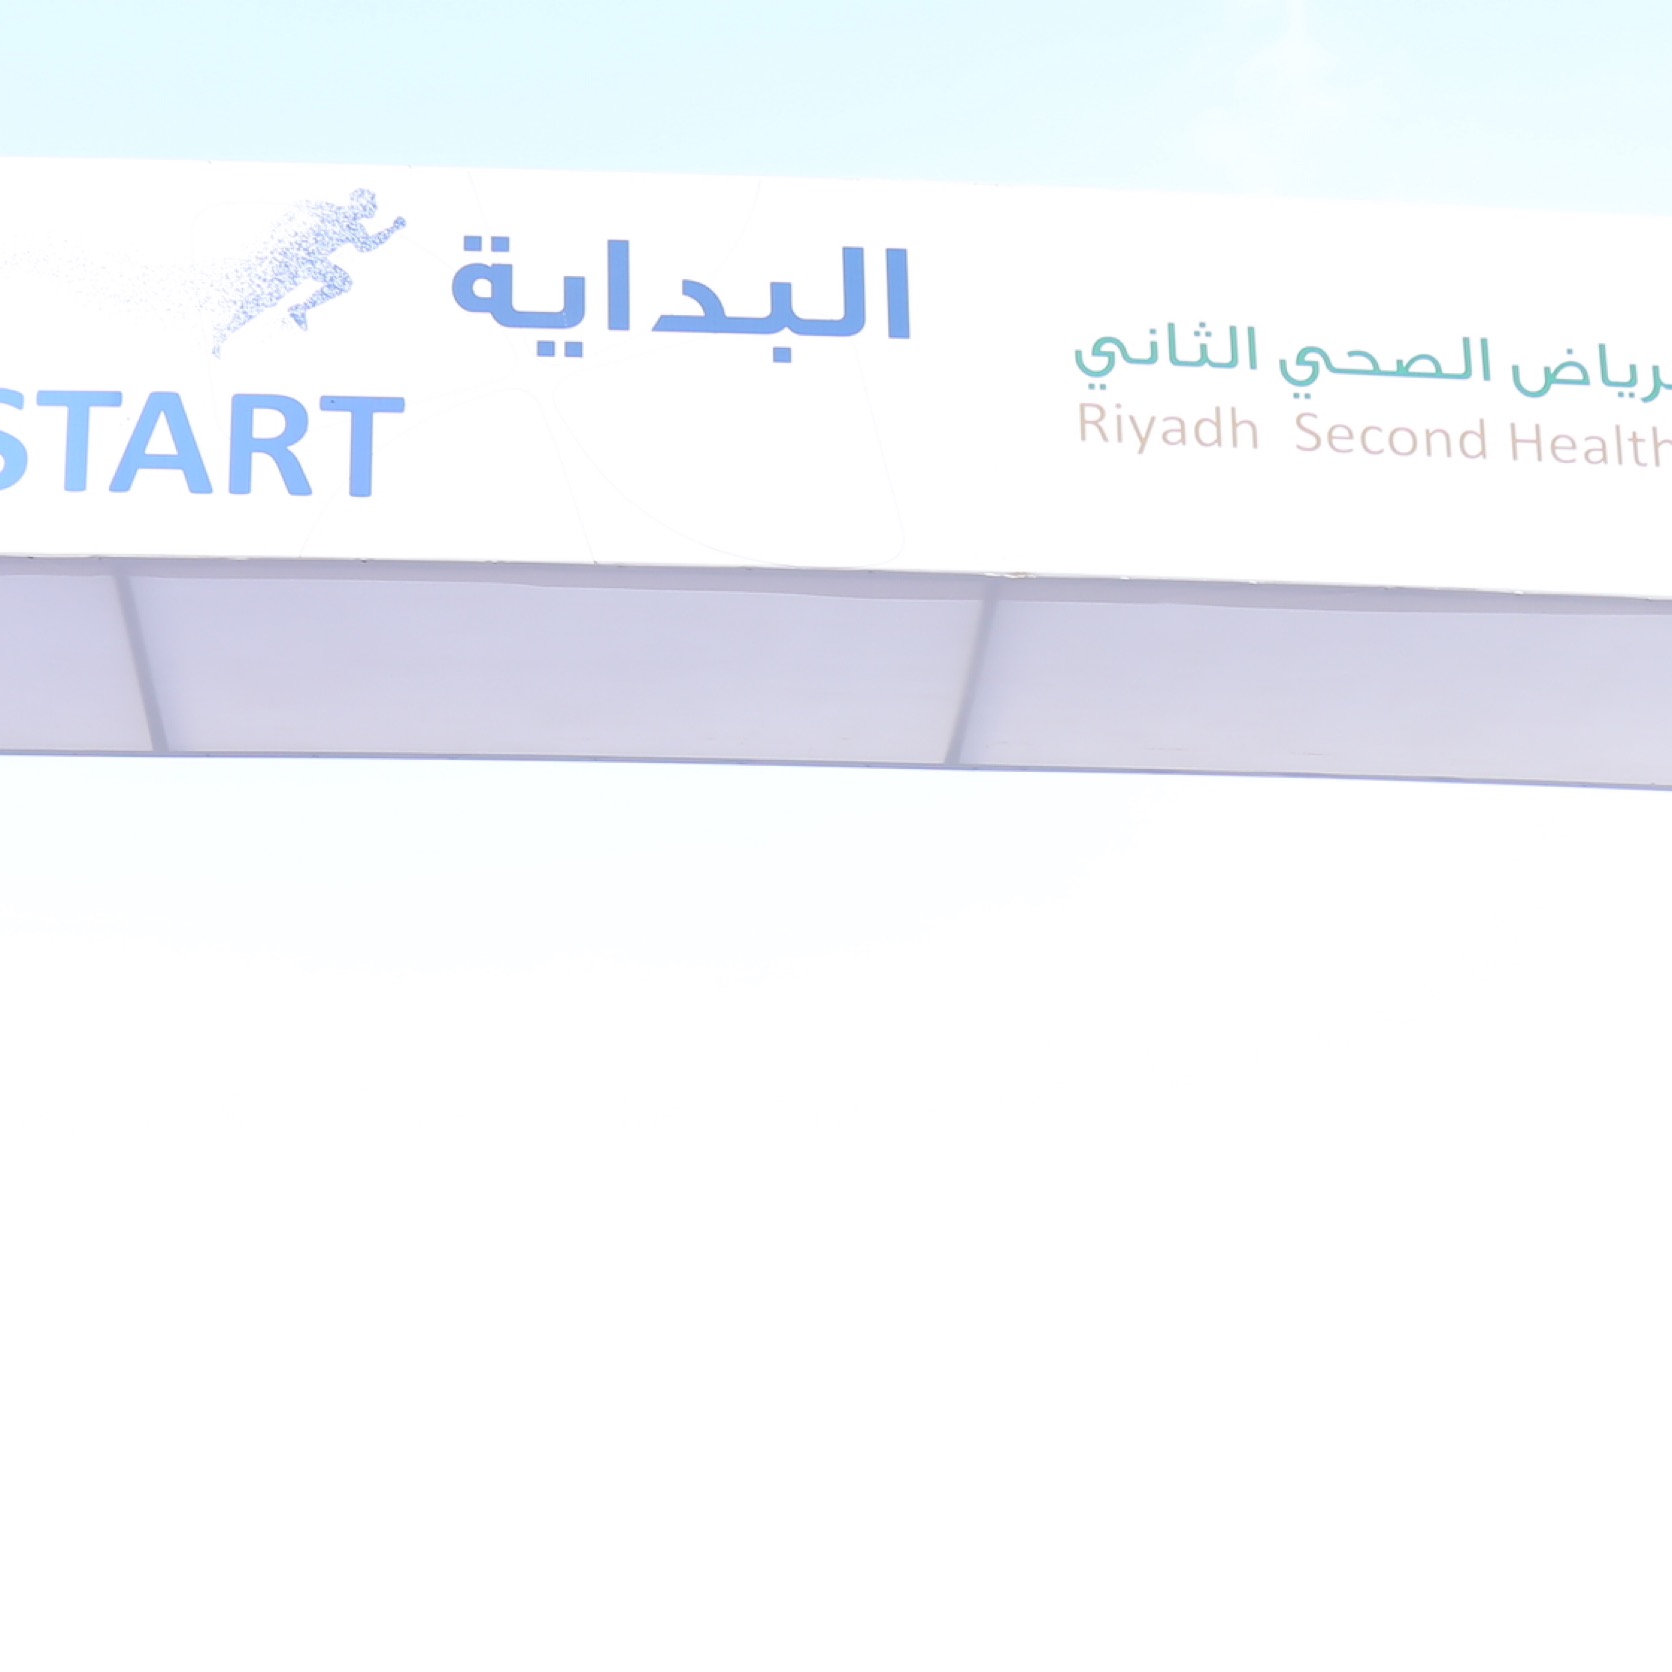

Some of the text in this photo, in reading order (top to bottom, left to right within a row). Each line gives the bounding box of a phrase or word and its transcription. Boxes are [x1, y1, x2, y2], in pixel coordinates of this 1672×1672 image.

[451, 235, 911, 364] البداية
[1074, 321, 1258, 391] الثاني
[1278, 336, 1491, 400] الصحي
[1078, 402, 1258, 455] Riyadh
[1295, 411, 1487, 460] Second
